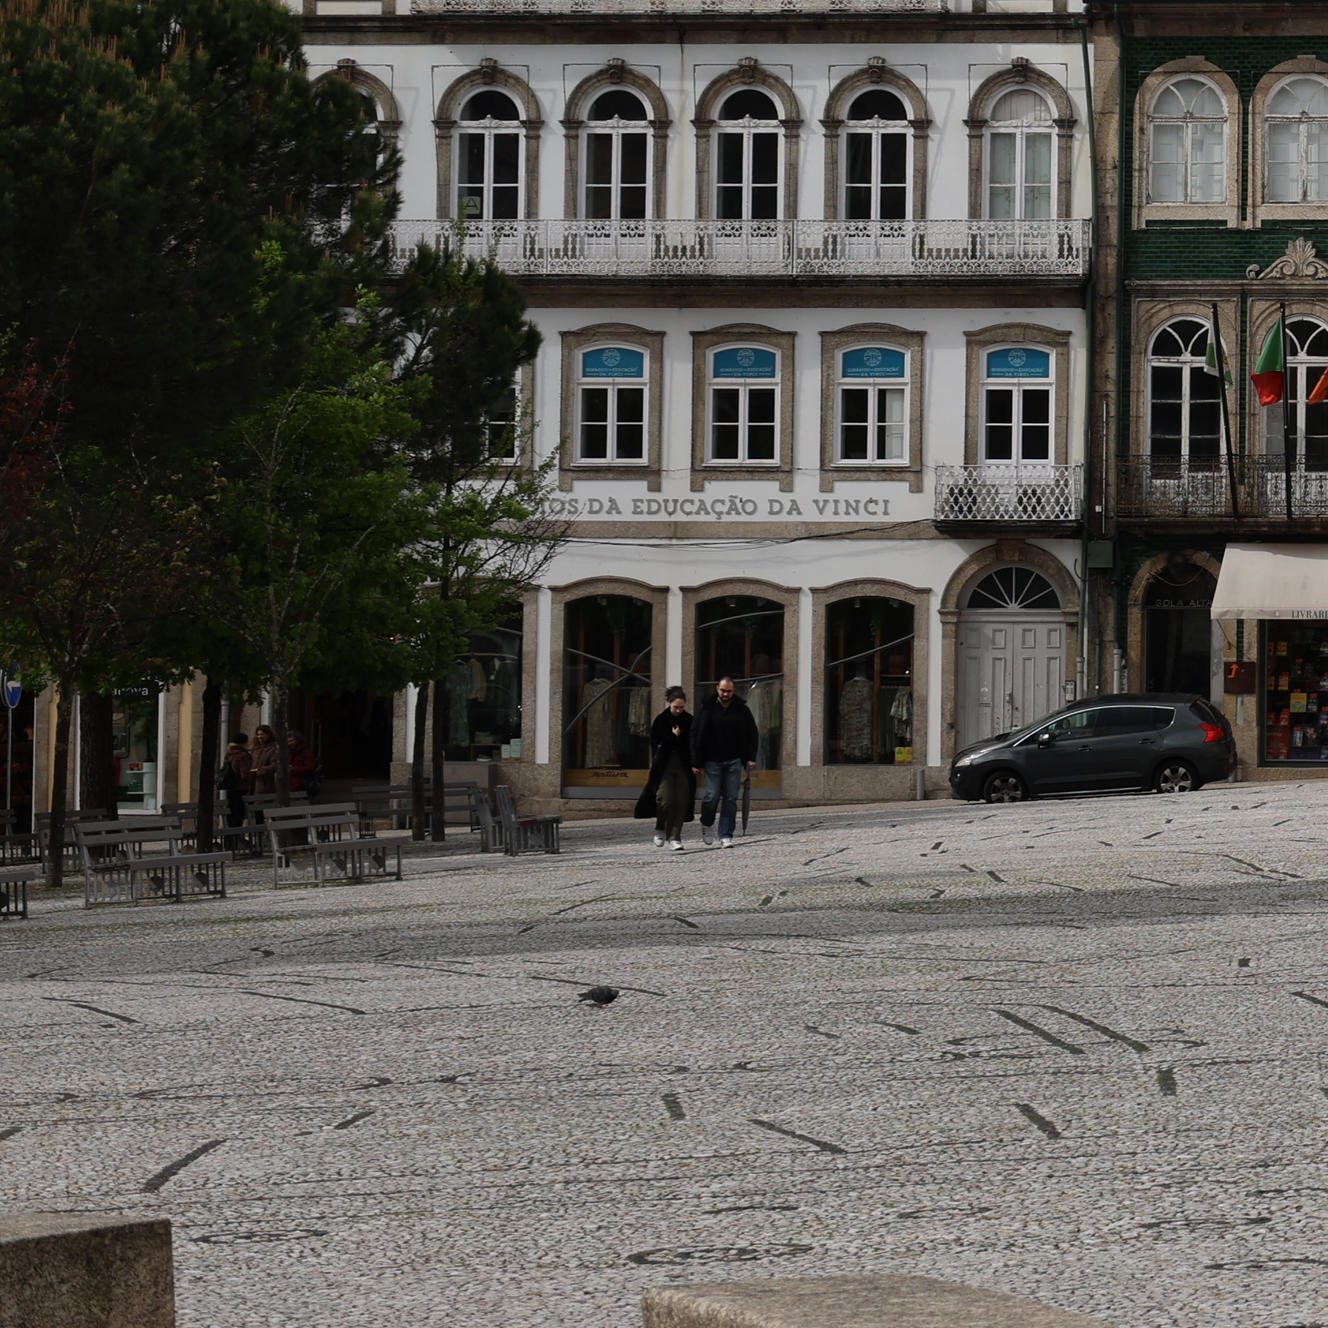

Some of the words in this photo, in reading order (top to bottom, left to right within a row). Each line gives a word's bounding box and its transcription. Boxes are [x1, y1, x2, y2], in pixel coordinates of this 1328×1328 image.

[587, 498, 622, 515] DA
[631, 495, 758, 520] EDUCAÇÃO
[768, 499, 803, 516] DA
[812, 499, 890, 516] VINCI
